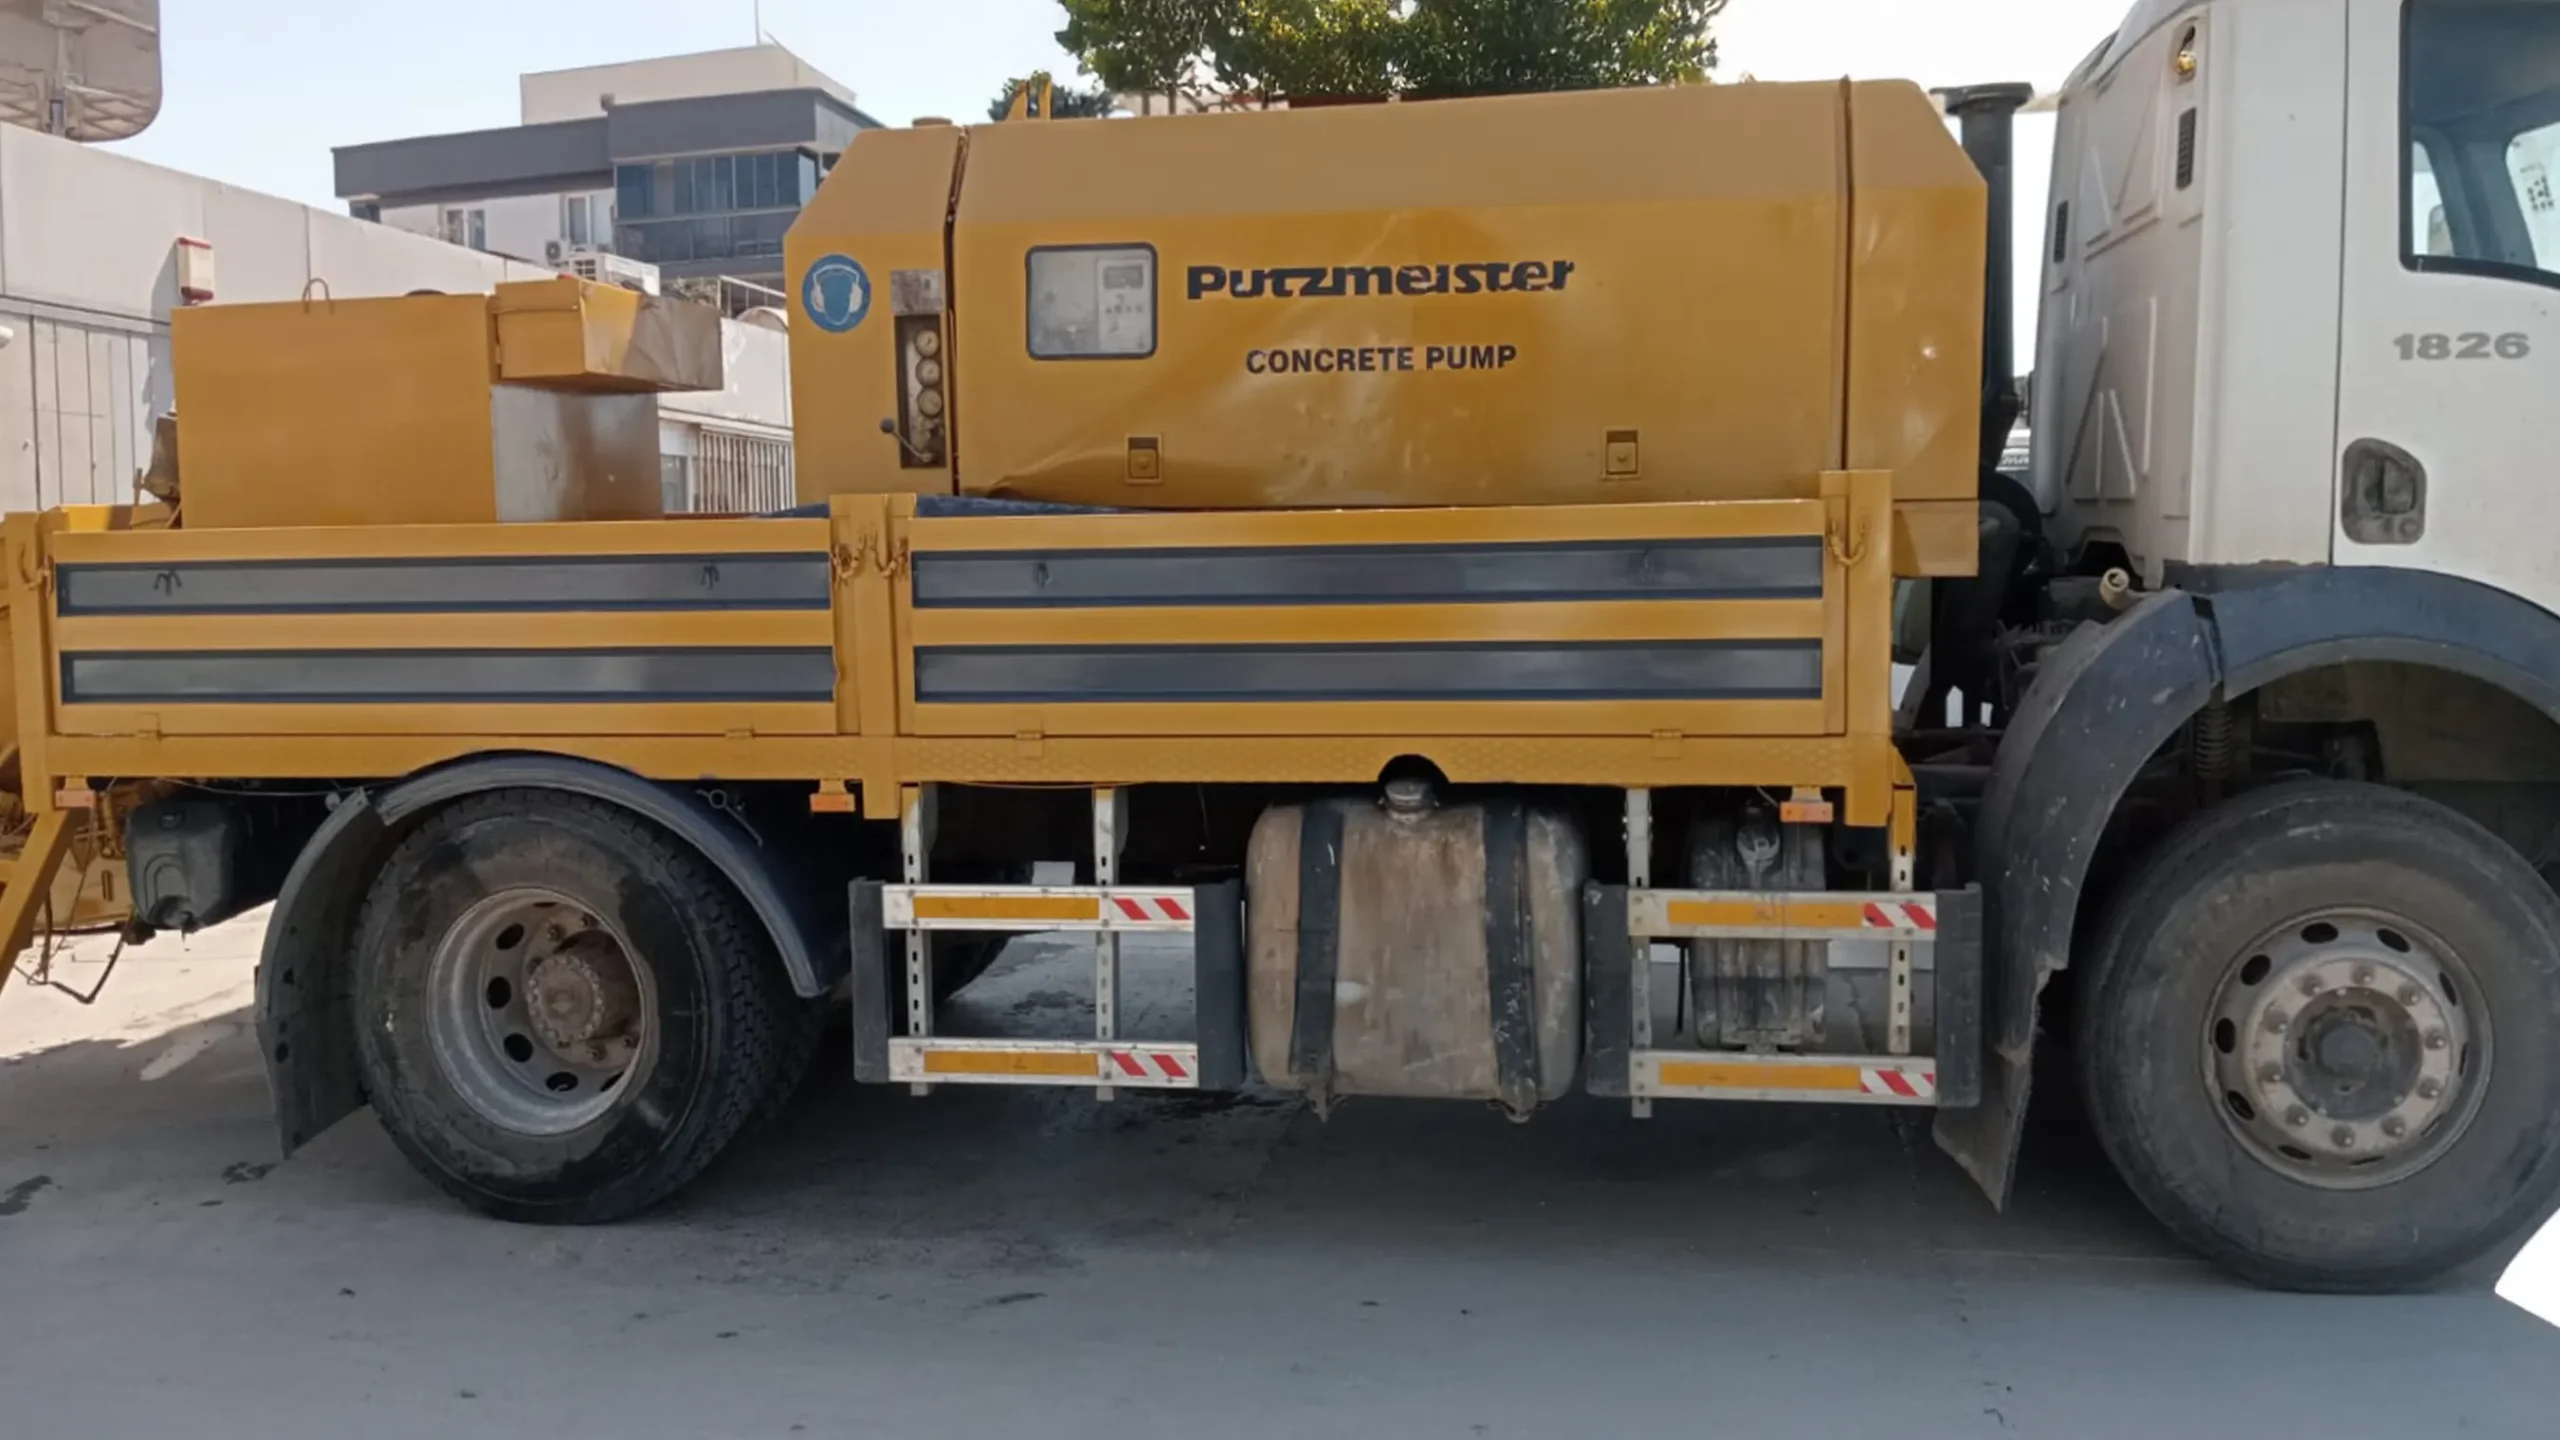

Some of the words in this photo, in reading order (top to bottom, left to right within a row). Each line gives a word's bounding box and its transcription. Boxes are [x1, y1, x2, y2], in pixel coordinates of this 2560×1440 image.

[1187, 260, 1574, 300] Putzmeister
[1246, 346, 1414, 374] CONCRETE
[1425, 344, 1517, 370] PUMP
[2393, 331, 2531, 361] 1826
